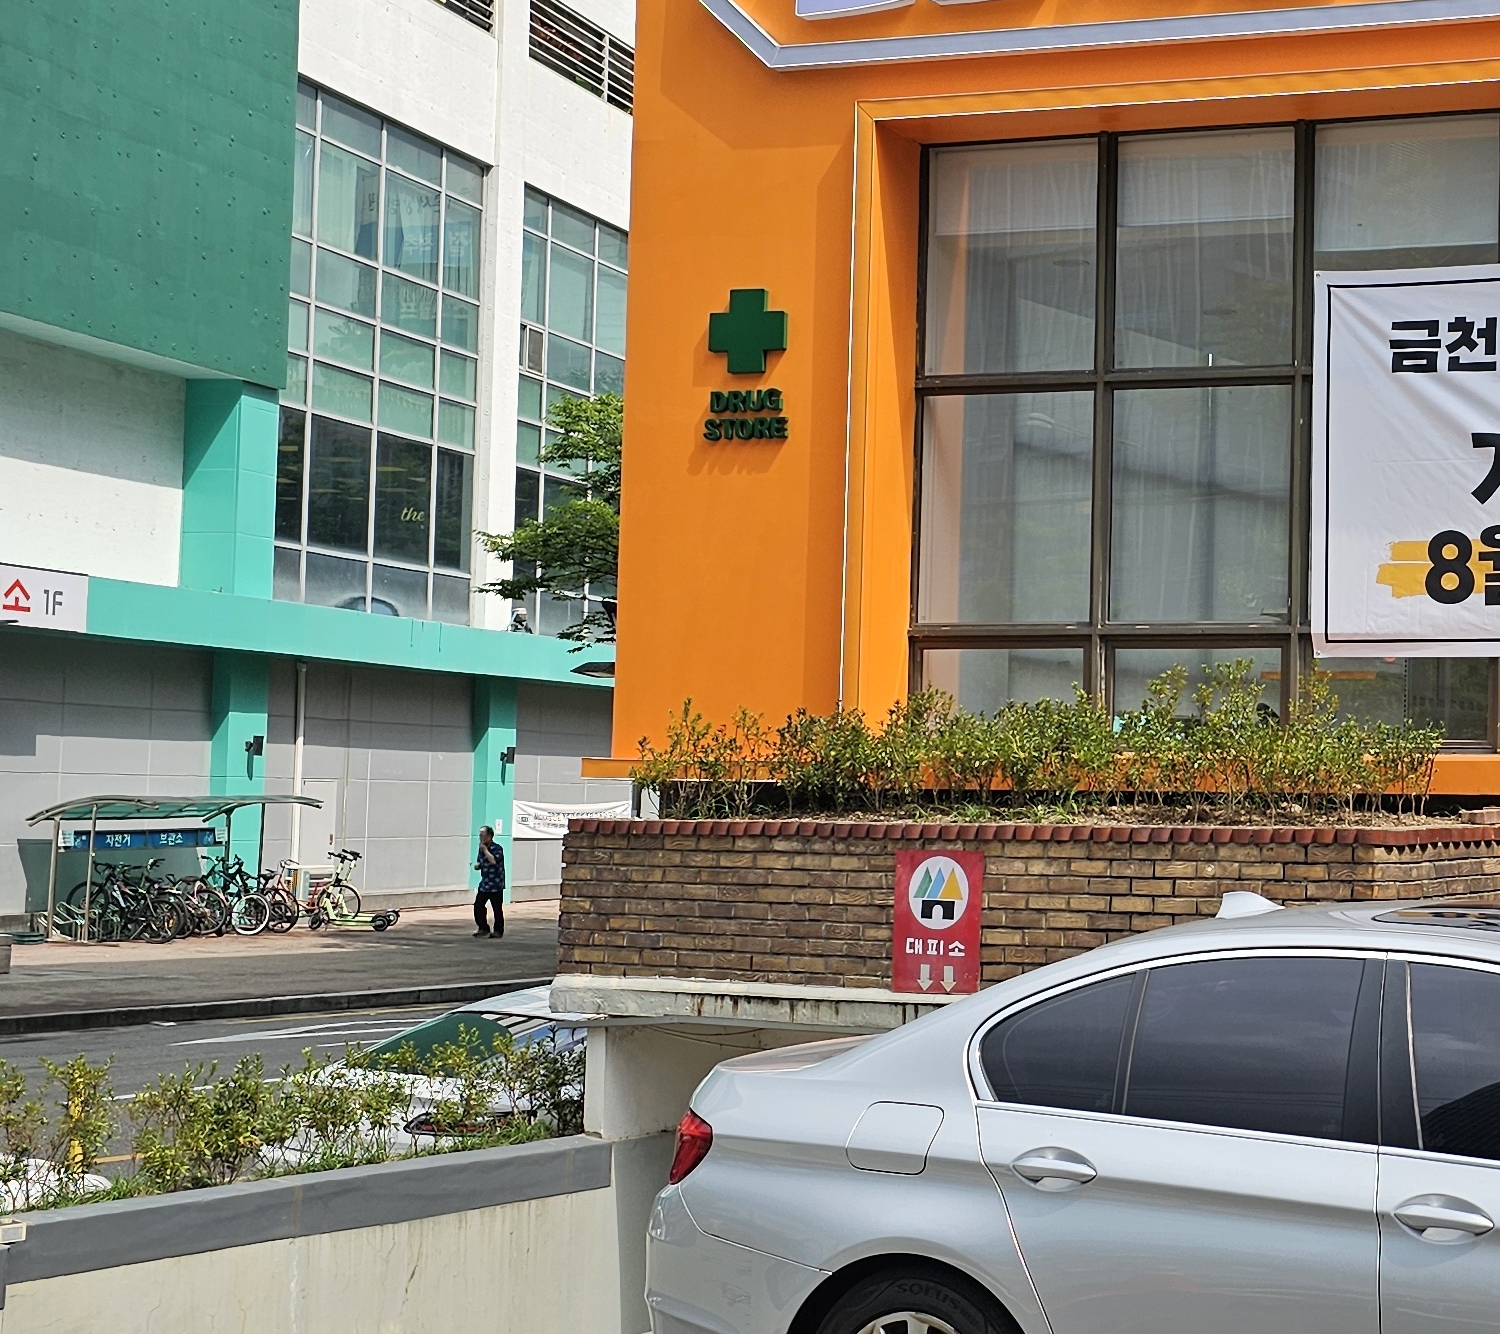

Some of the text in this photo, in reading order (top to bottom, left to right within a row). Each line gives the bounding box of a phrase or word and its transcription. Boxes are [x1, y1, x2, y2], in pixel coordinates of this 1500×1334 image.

[710, 388, 783, 413] DRUG
[703, 417, 789, 441] STORE
[43, 589, 64, 616] 1F
[105, 833, 131, 847] 자전거
[905, 937, 966, 957] 대피소
